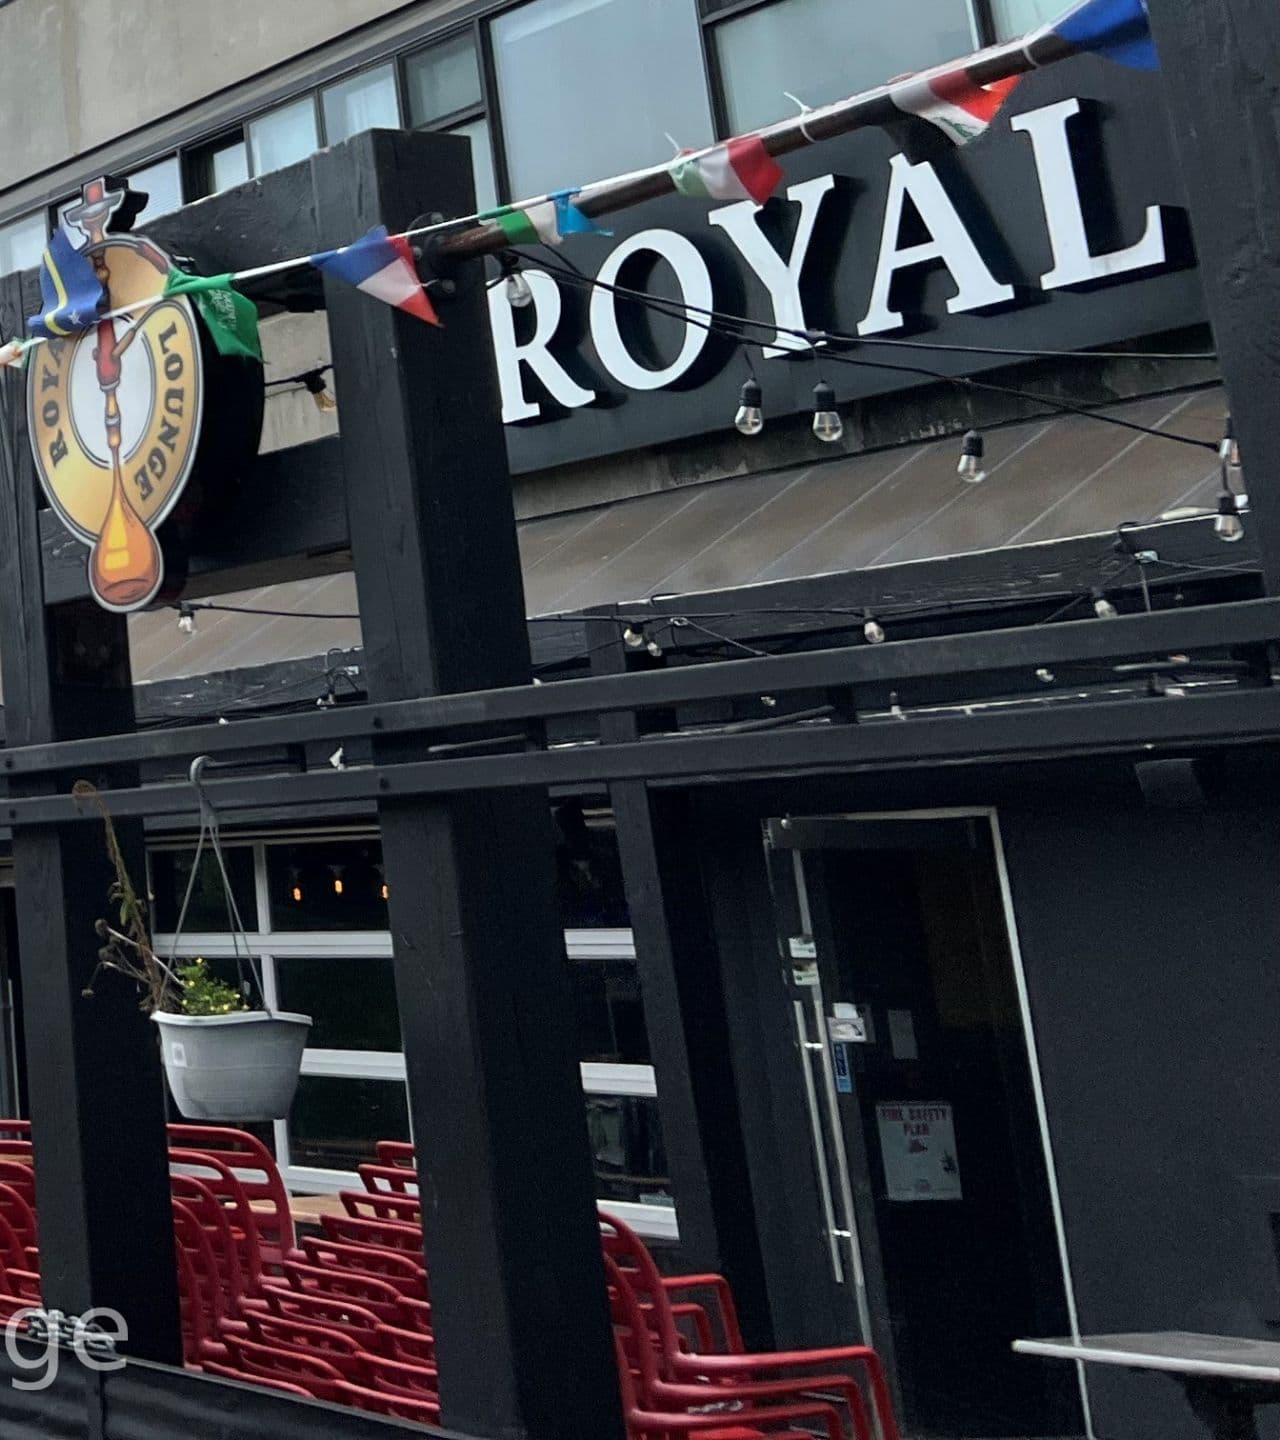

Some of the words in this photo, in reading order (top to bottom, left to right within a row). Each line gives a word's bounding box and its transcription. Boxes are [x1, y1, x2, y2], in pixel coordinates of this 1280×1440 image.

[487, 97, 1166, 424] ROYAL
[42, 338, 68, 468] ROYA
[134, 321, 184, 501] LOUNGE
